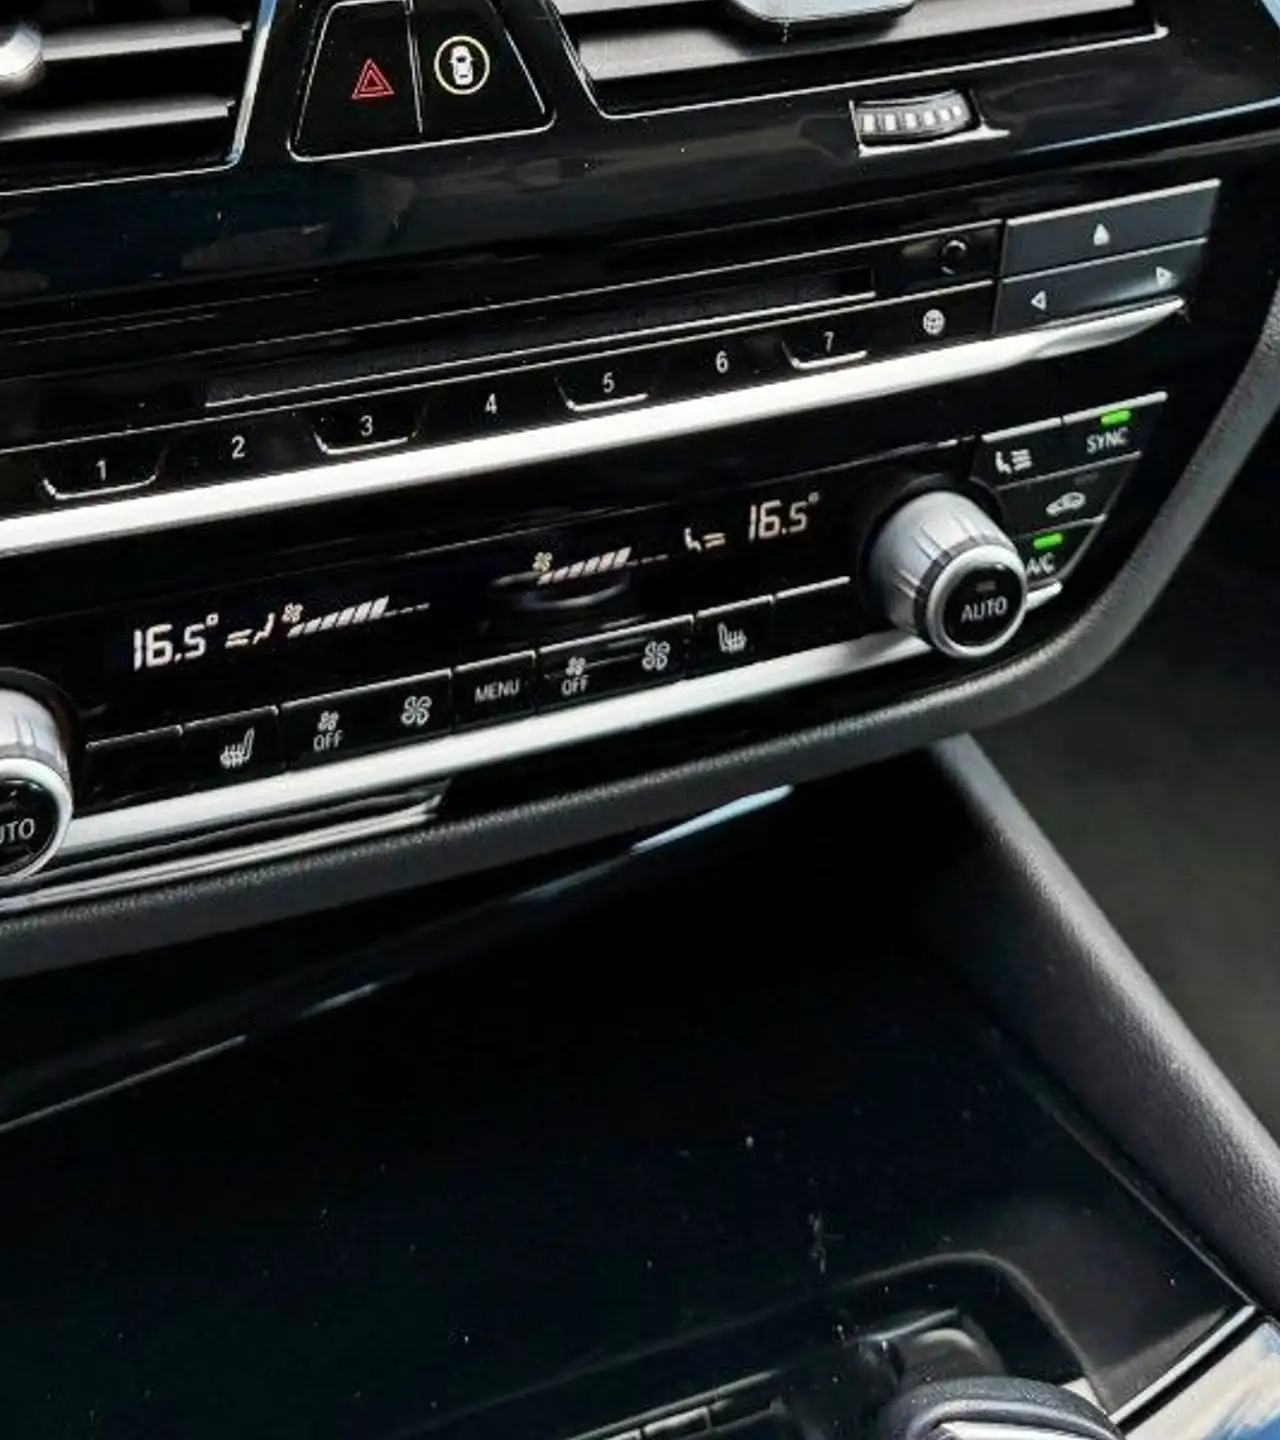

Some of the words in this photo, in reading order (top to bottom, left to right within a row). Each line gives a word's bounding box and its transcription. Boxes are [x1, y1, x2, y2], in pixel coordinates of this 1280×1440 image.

[822, 330, 835, 353] 7
[714, 349, 730, 375] 6
[601, 371, 616, 395] 5
[484, 391, 499, 416] 4
[359, 414, 375, 438] 3
[230, 434, 247, 459] 2
[1085, 426, 1131, 455] SYNC
[95, 459, 108, 481] 1
[960, 596, 1010, 624] AUTO
[474, 677, 522, 704] MENU
[562, 673, 591, 696] OFF
[312, 729, 345, 753] OFF
